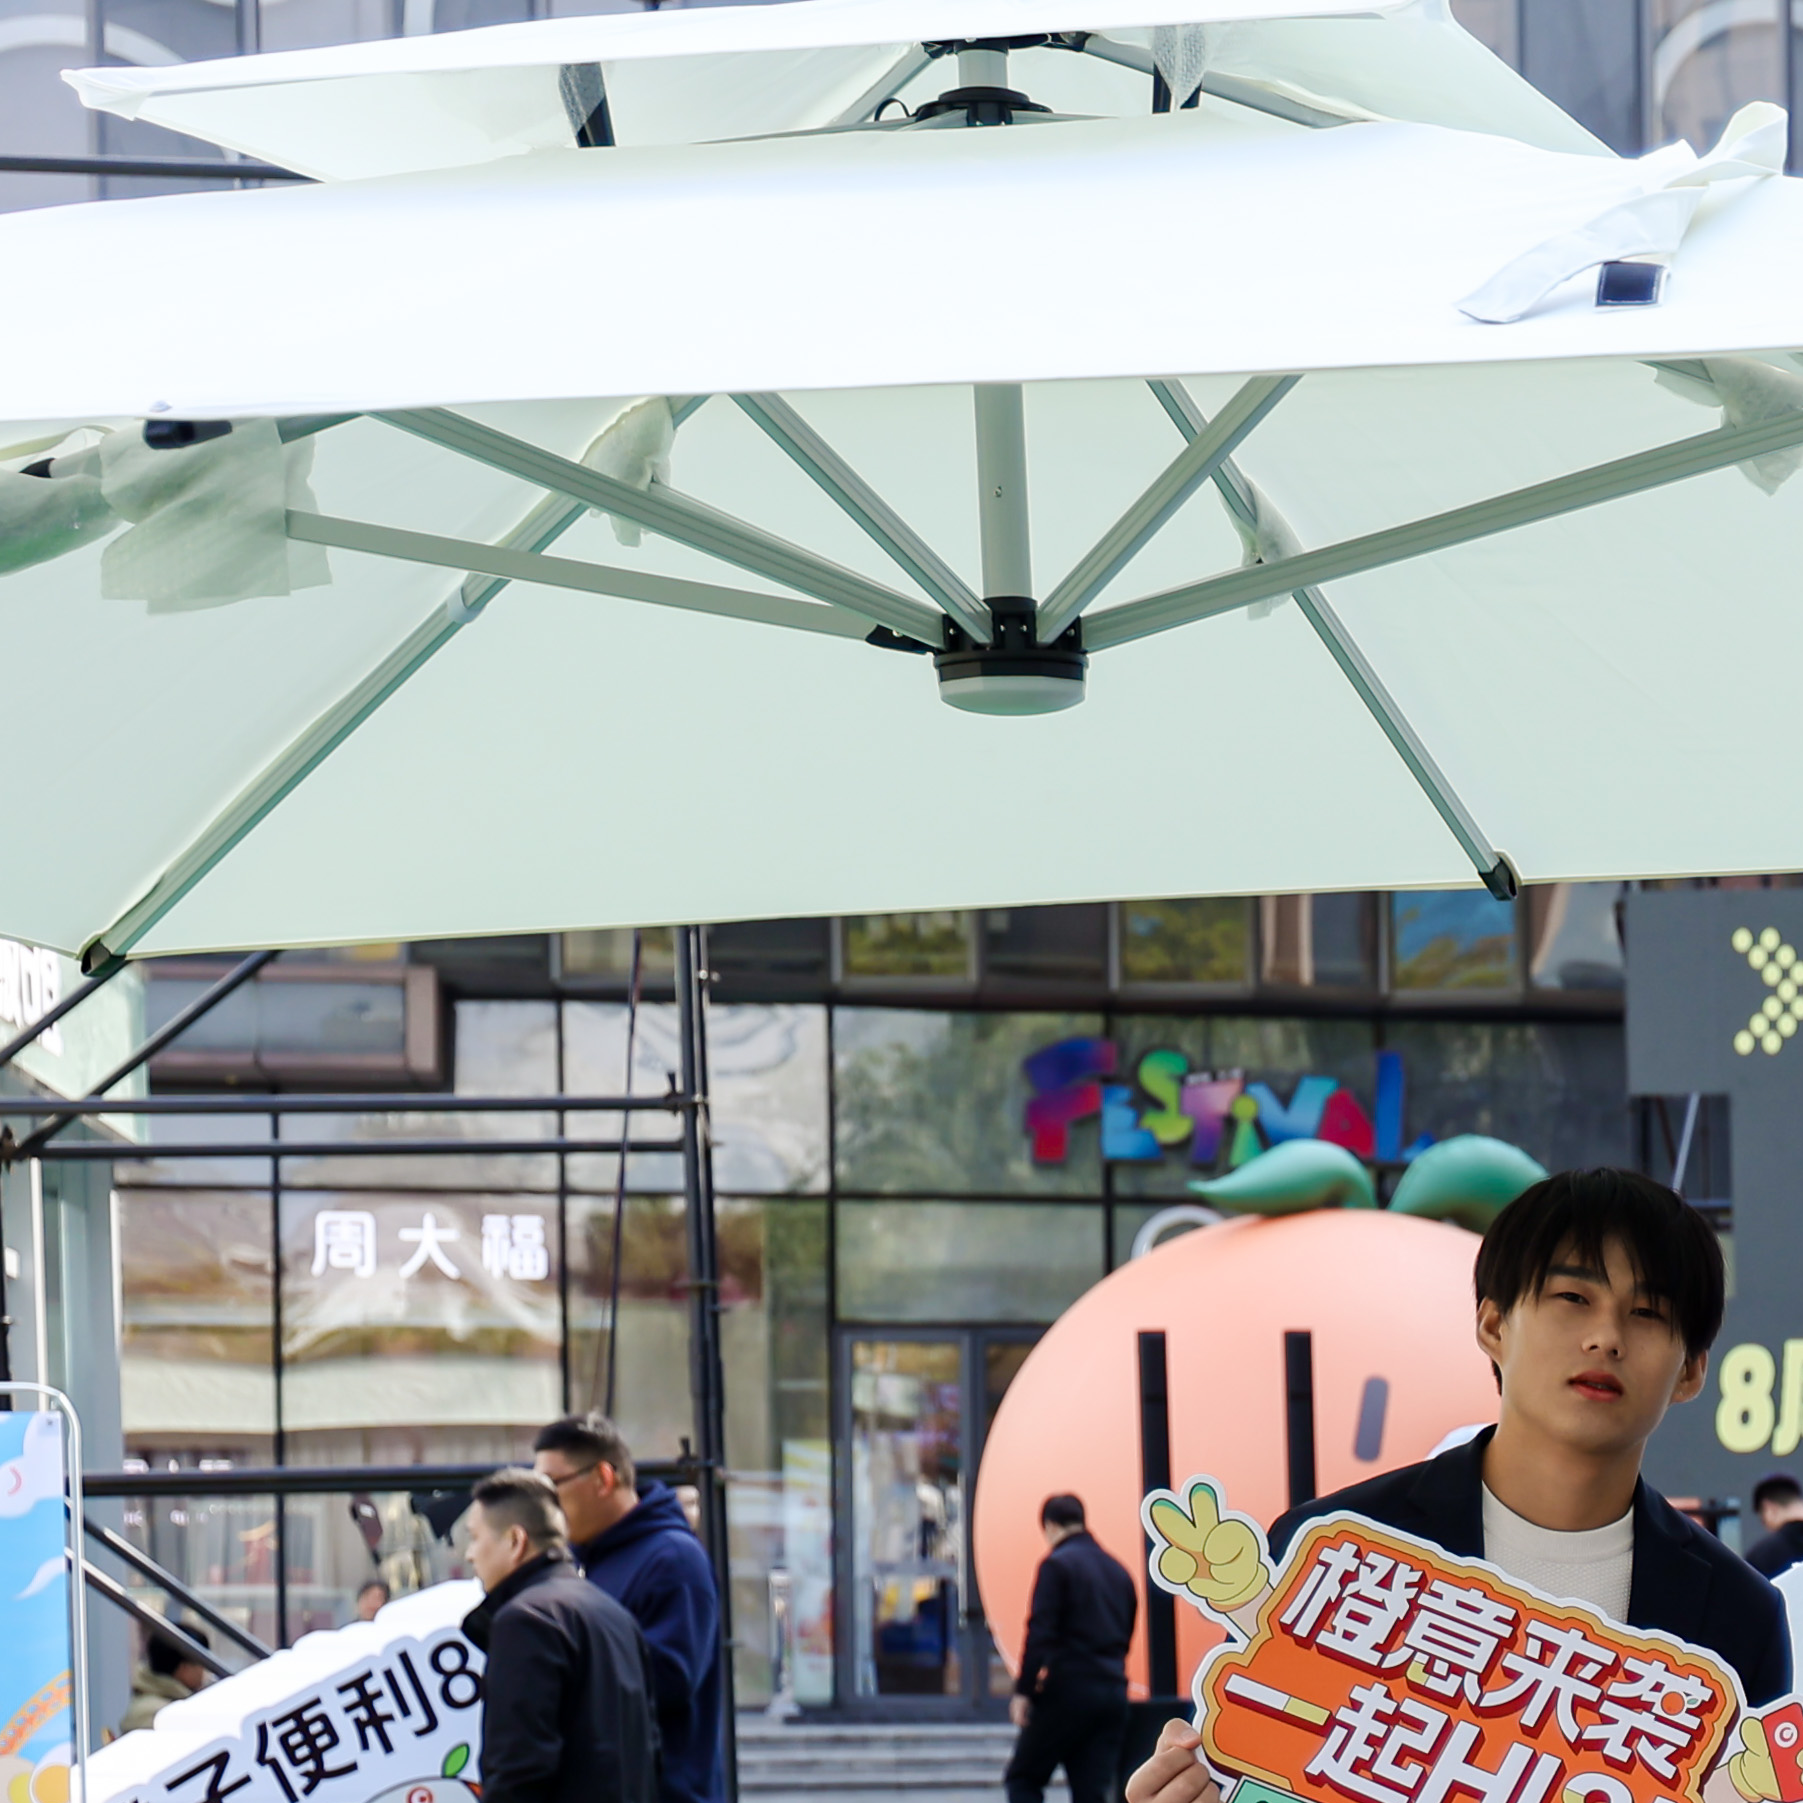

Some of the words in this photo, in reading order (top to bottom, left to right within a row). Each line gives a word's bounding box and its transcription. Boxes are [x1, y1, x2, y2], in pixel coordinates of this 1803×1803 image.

[312, 1209, 549, 1281] 周大福
[1280, 1541, 1711, 1781] 橙意来袭
